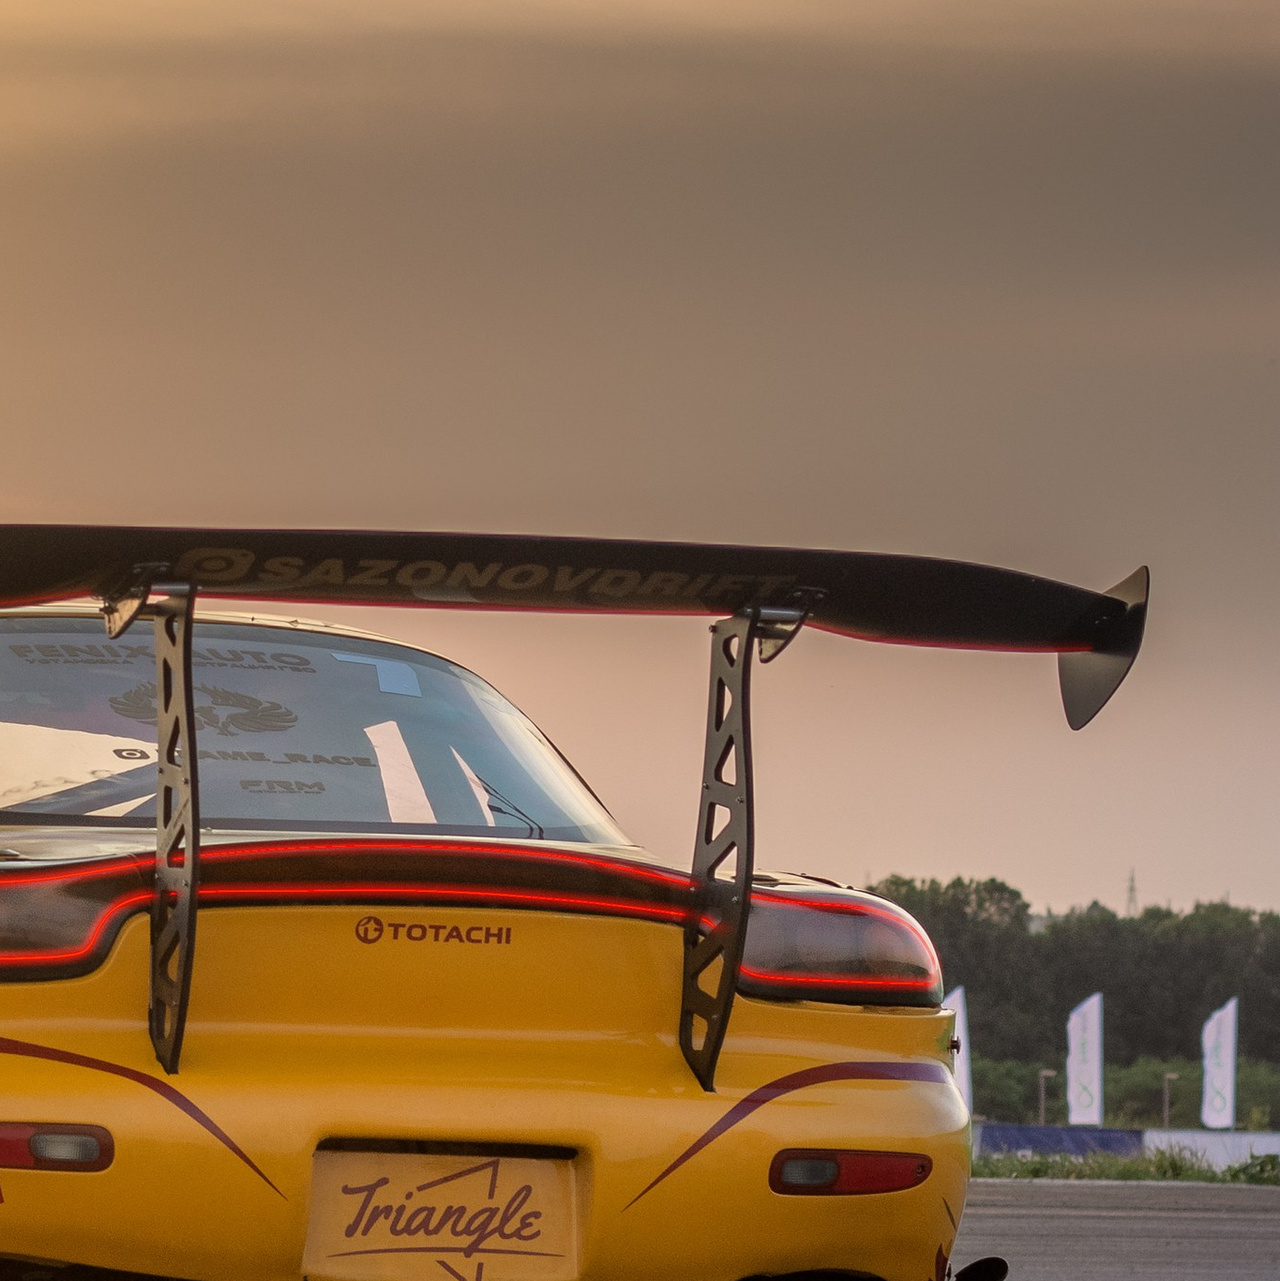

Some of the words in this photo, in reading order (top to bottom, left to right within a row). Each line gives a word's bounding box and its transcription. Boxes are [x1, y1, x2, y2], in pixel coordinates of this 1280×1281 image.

[258, 554, 798, 600] SAZONOVDRIFT
[9, 644, 156, 658] FENIX
[156, 748, 377, 768] AME_RACE
[239, 779, 326, 792] FRM
[388, 922, 512, 945] TOTACHI
[341, 1176, 542, 1257] Triangle
